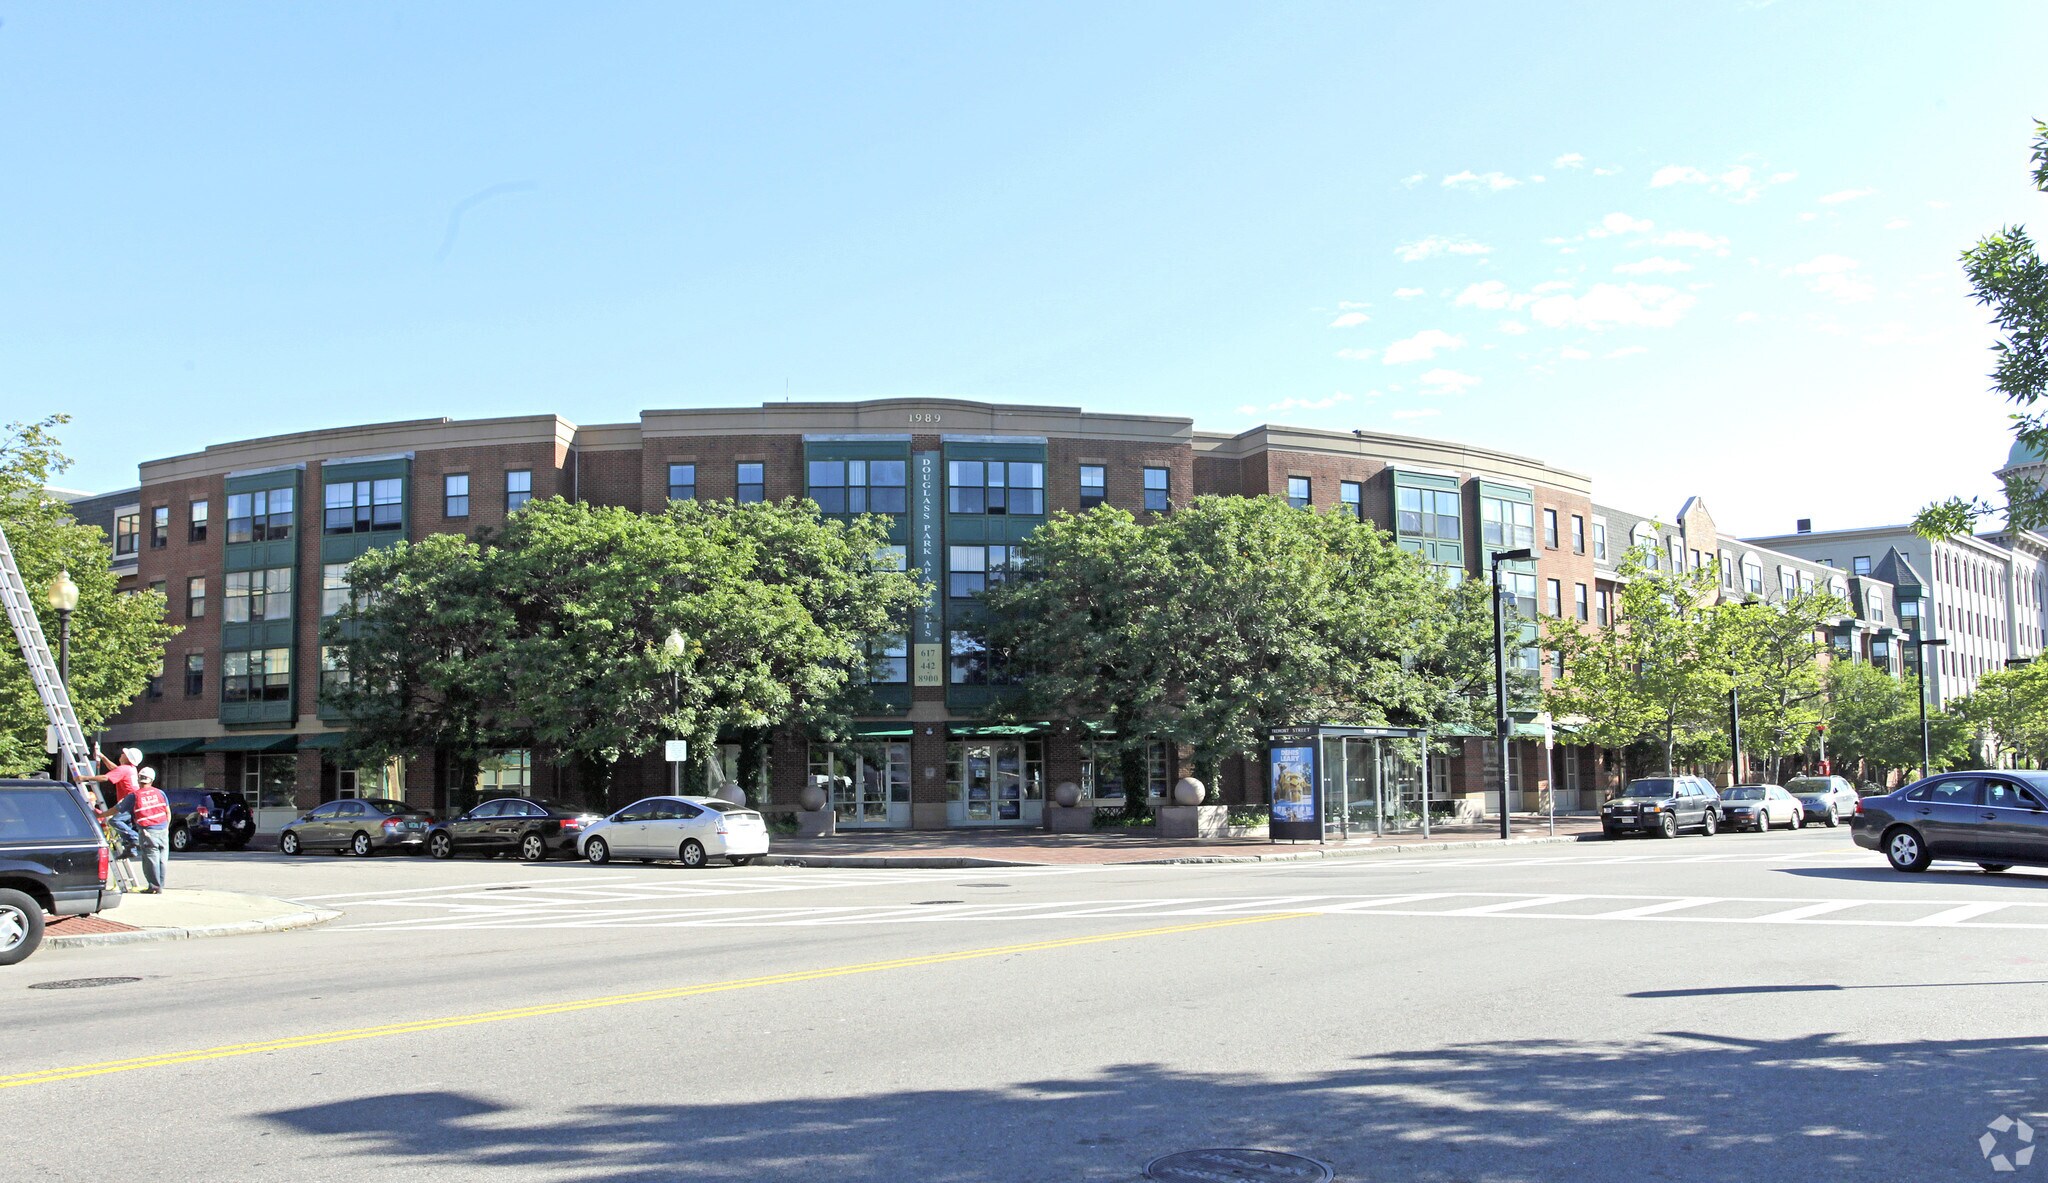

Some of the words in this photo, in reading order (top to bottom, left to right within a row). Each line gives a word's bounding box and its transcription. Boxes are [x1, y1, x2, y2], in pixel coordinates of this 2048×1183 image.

[909, 413, 941, 423] 1989
[922, 458, 931, 520] DOUGLASS
[923, 524, 932, 555] PARK
[923, 560, 932, 637] APAENTS
[920, 649, 936, 657] 617
[920, 662, 936, 670] 442
[918, 674, 939, 682] 8900
